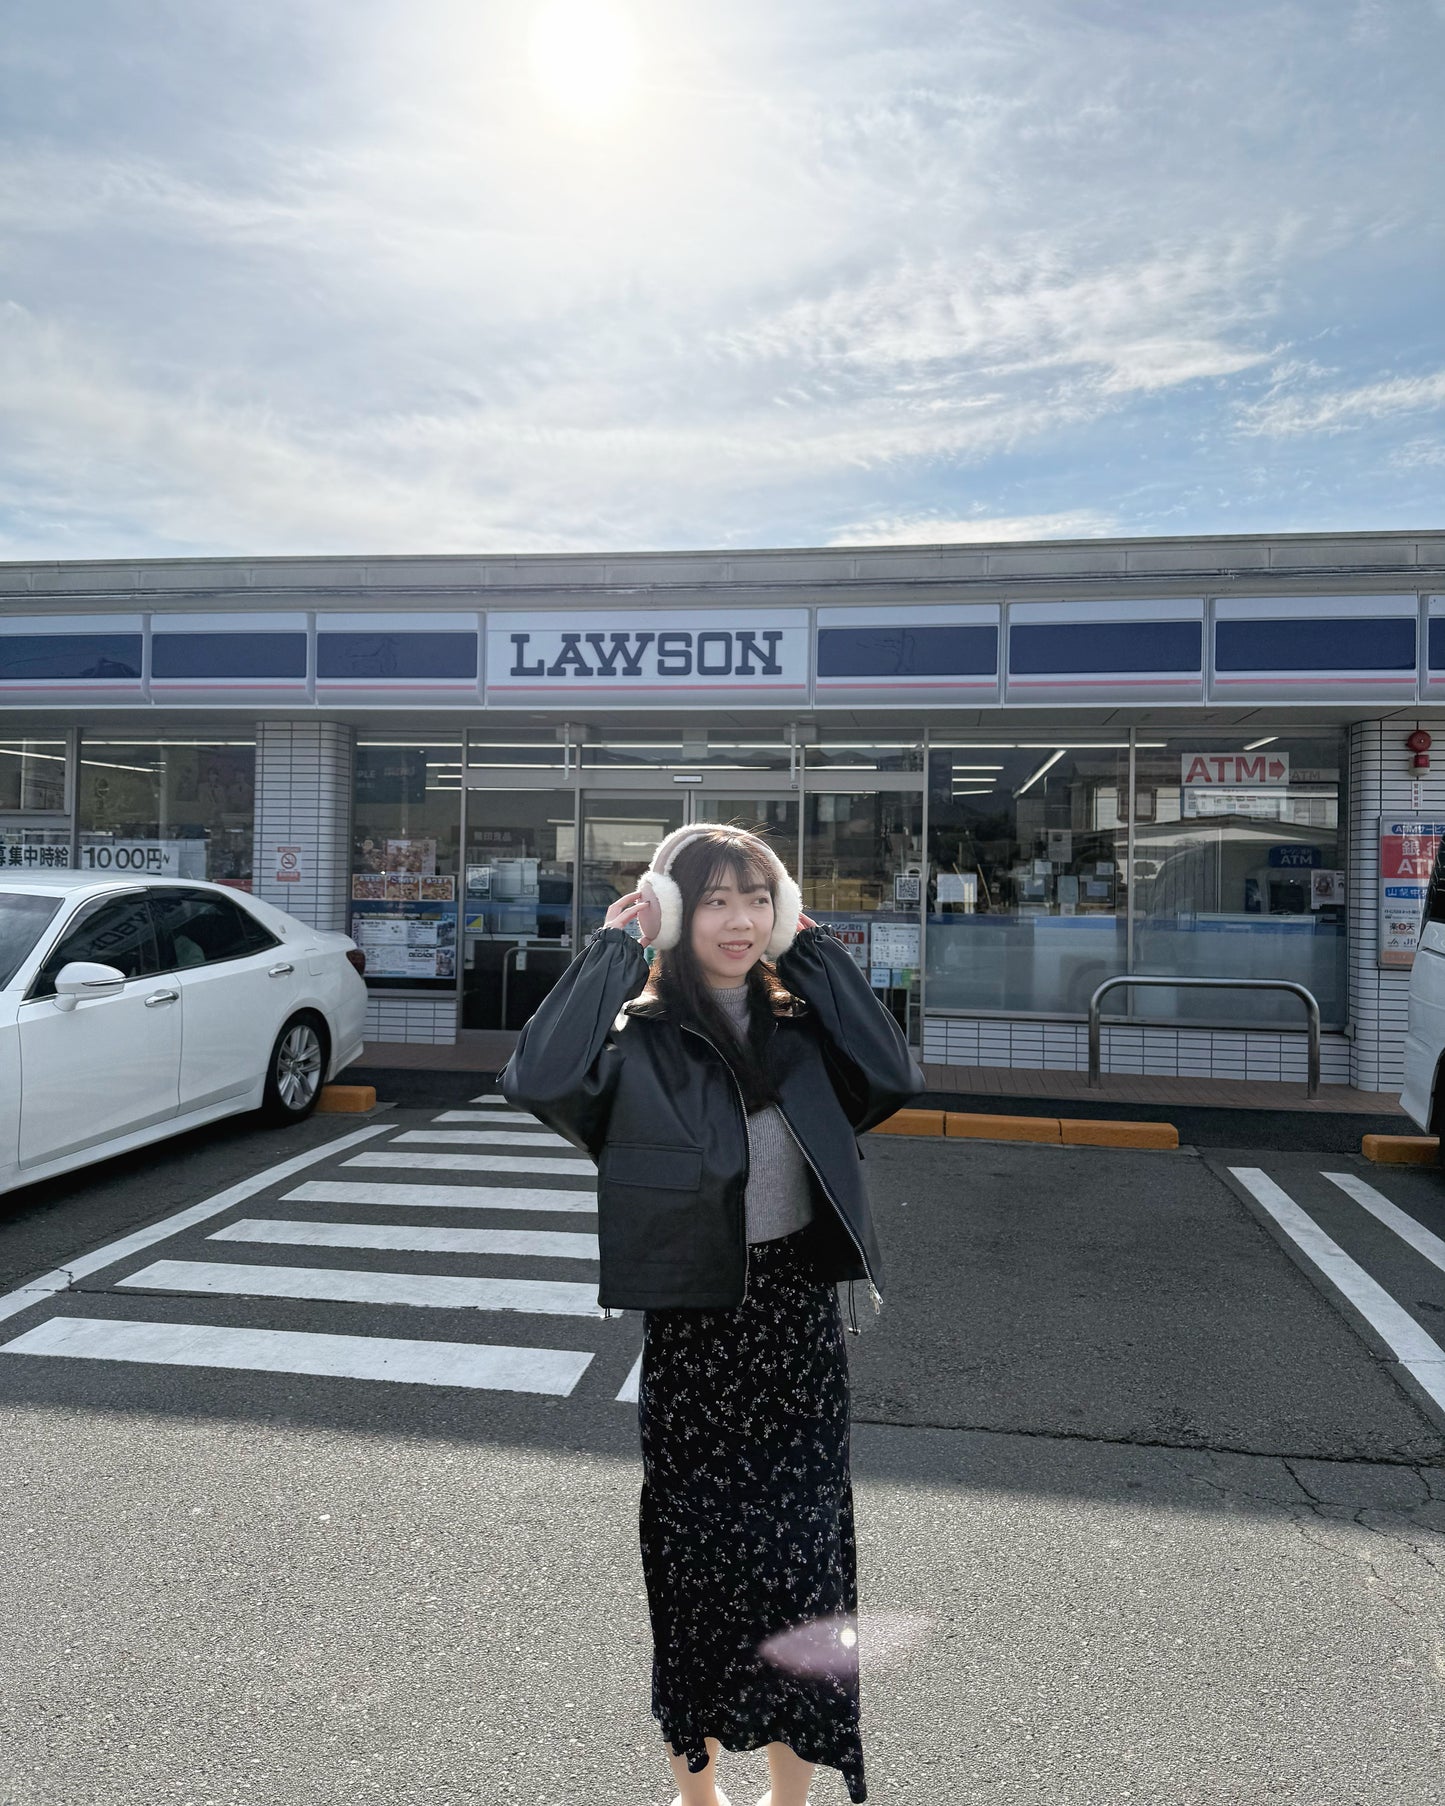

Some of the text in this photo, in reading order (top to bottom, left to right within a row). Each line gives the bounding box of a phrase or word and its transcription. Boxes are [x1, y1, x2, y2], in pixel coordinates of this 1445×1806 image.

[510, 631, 783, 676] LAWSON
[1185, 756, 1266, 783] ATM
[1280, 855, 1313, 864] ATM
